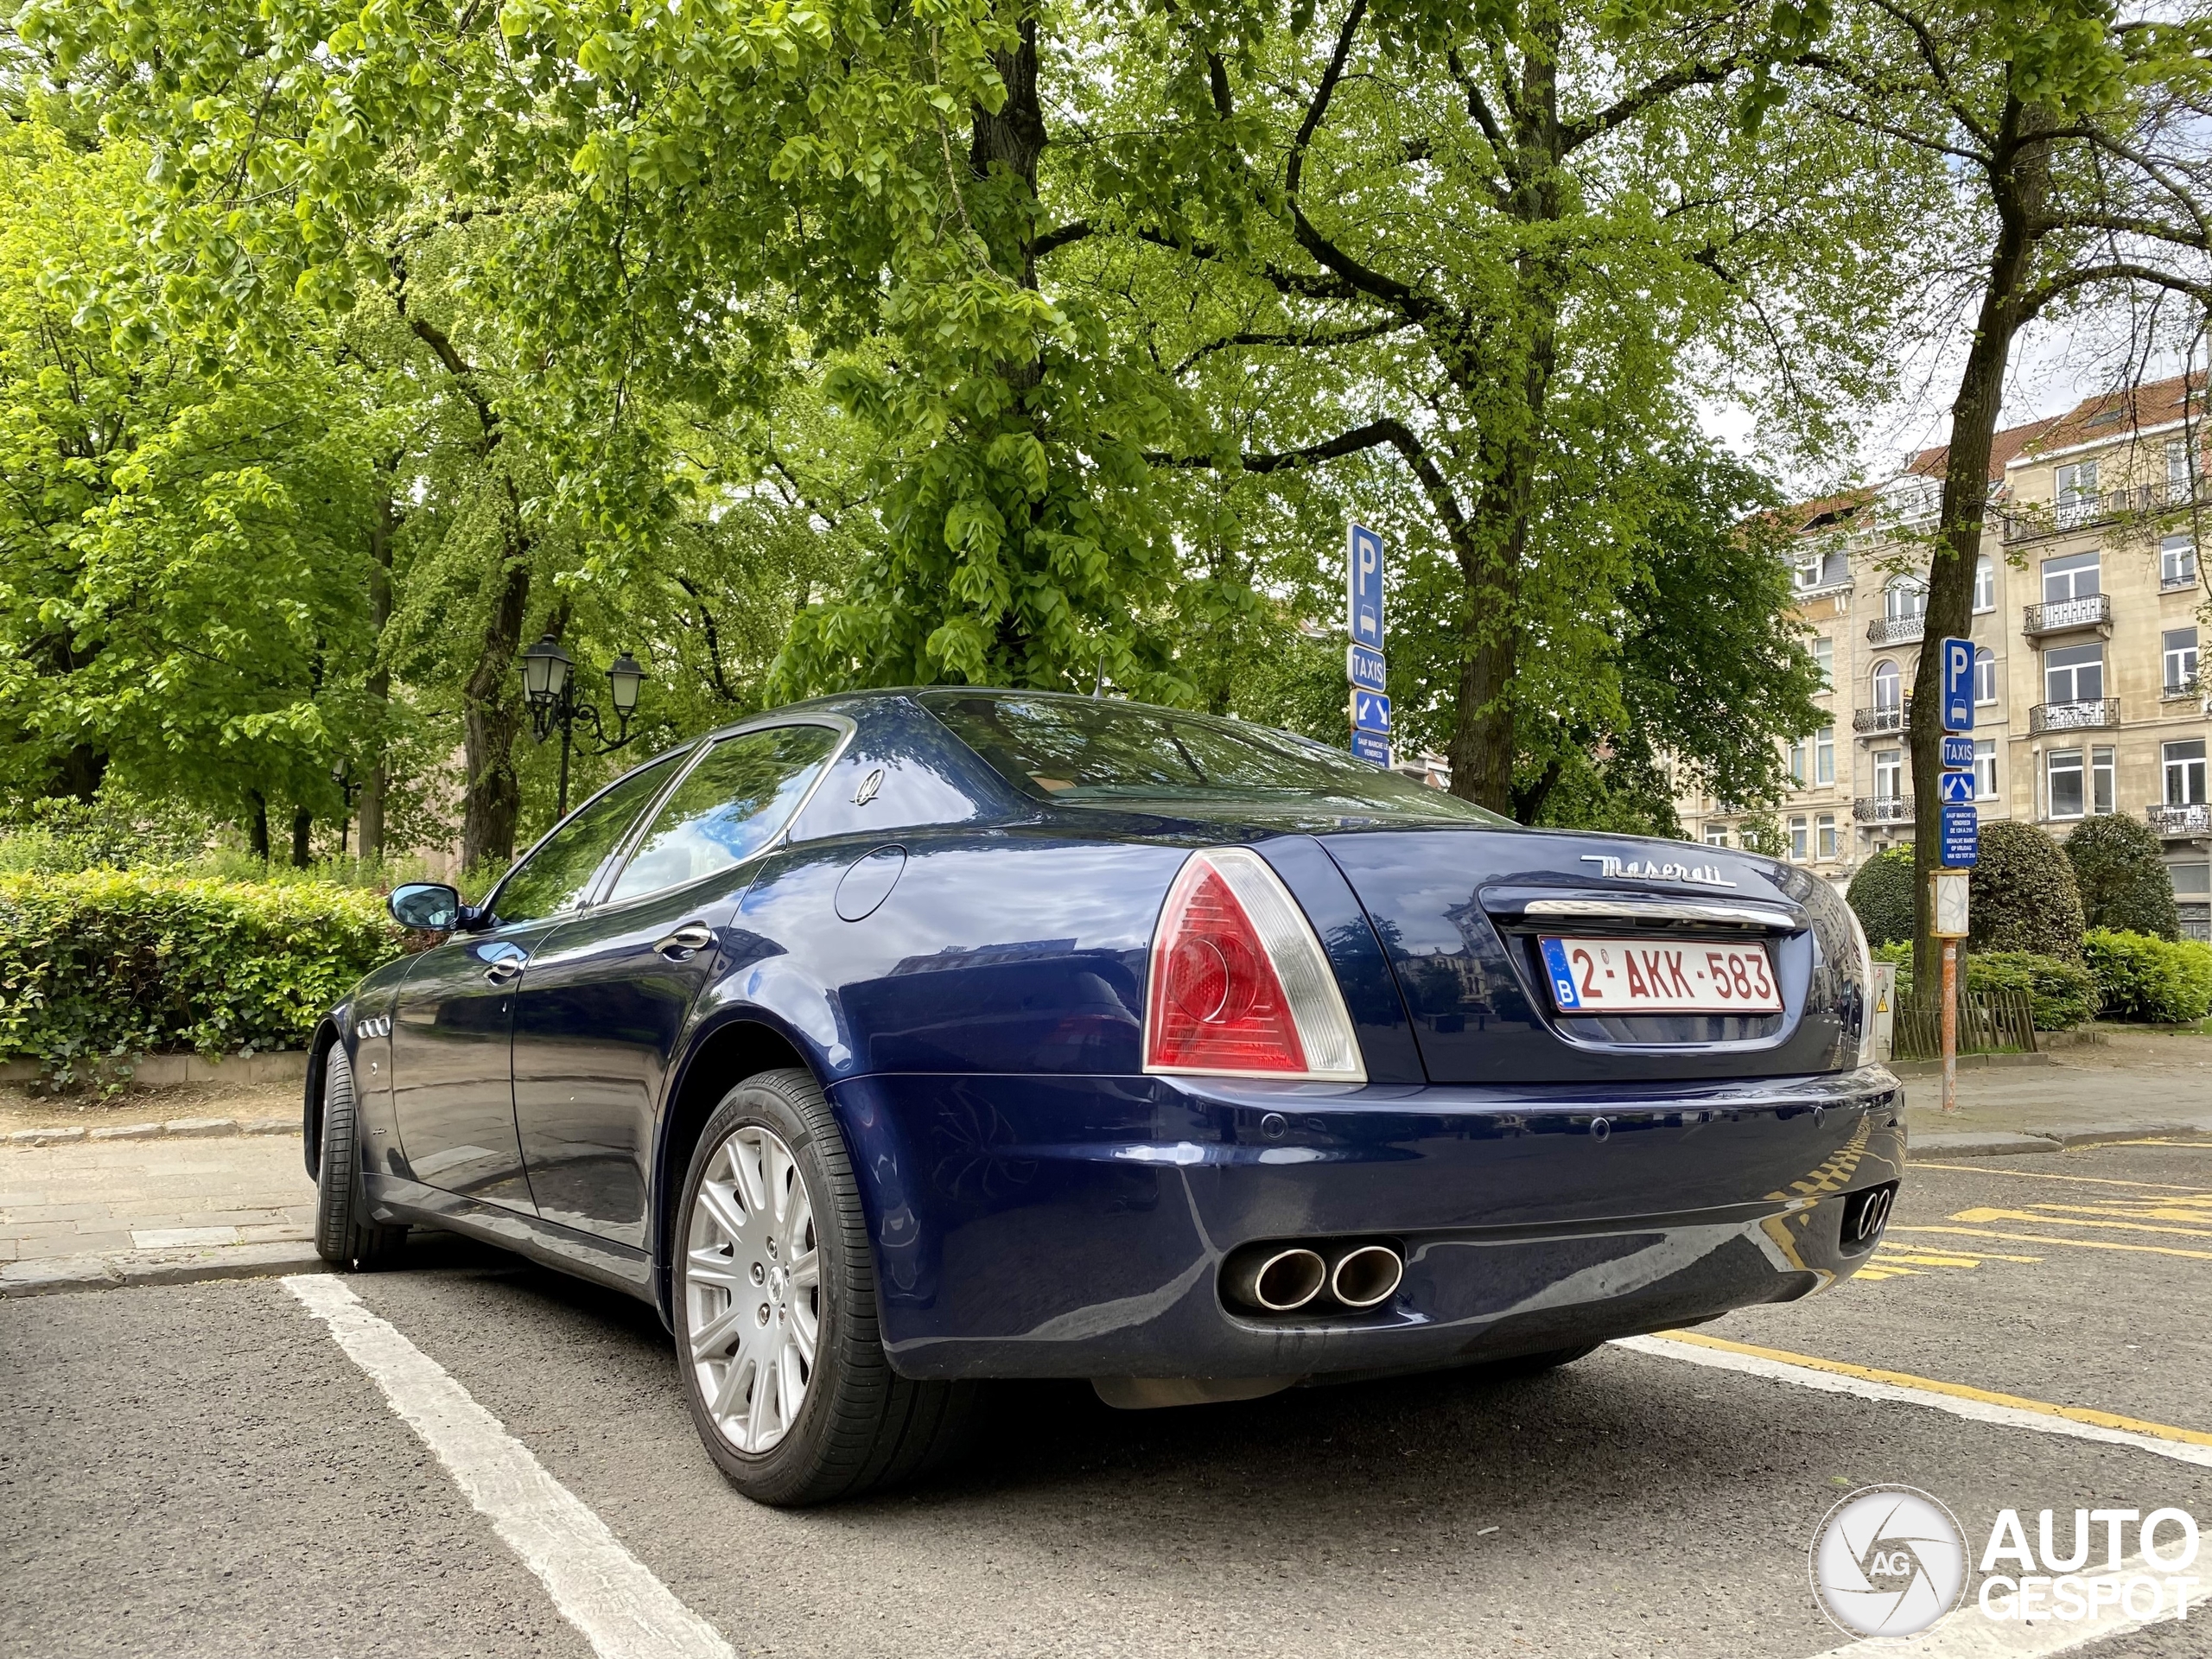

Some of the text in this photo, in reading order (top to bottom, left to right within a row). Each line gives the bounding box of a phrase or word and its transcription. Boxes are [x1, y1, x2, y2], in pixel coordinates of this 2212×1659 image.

[1359, 536, 1376, 596] P
[1353, 654, 1383, 683] TAXIS
[1951, 646, 1967, 693] P
[1358, 737, 1368, 746] SAUF
[1945, 743, 1973, 761] TAXIS
[1580, 855, 1738, 888] Maserati
[1556, 979, 1574, 1003] B
